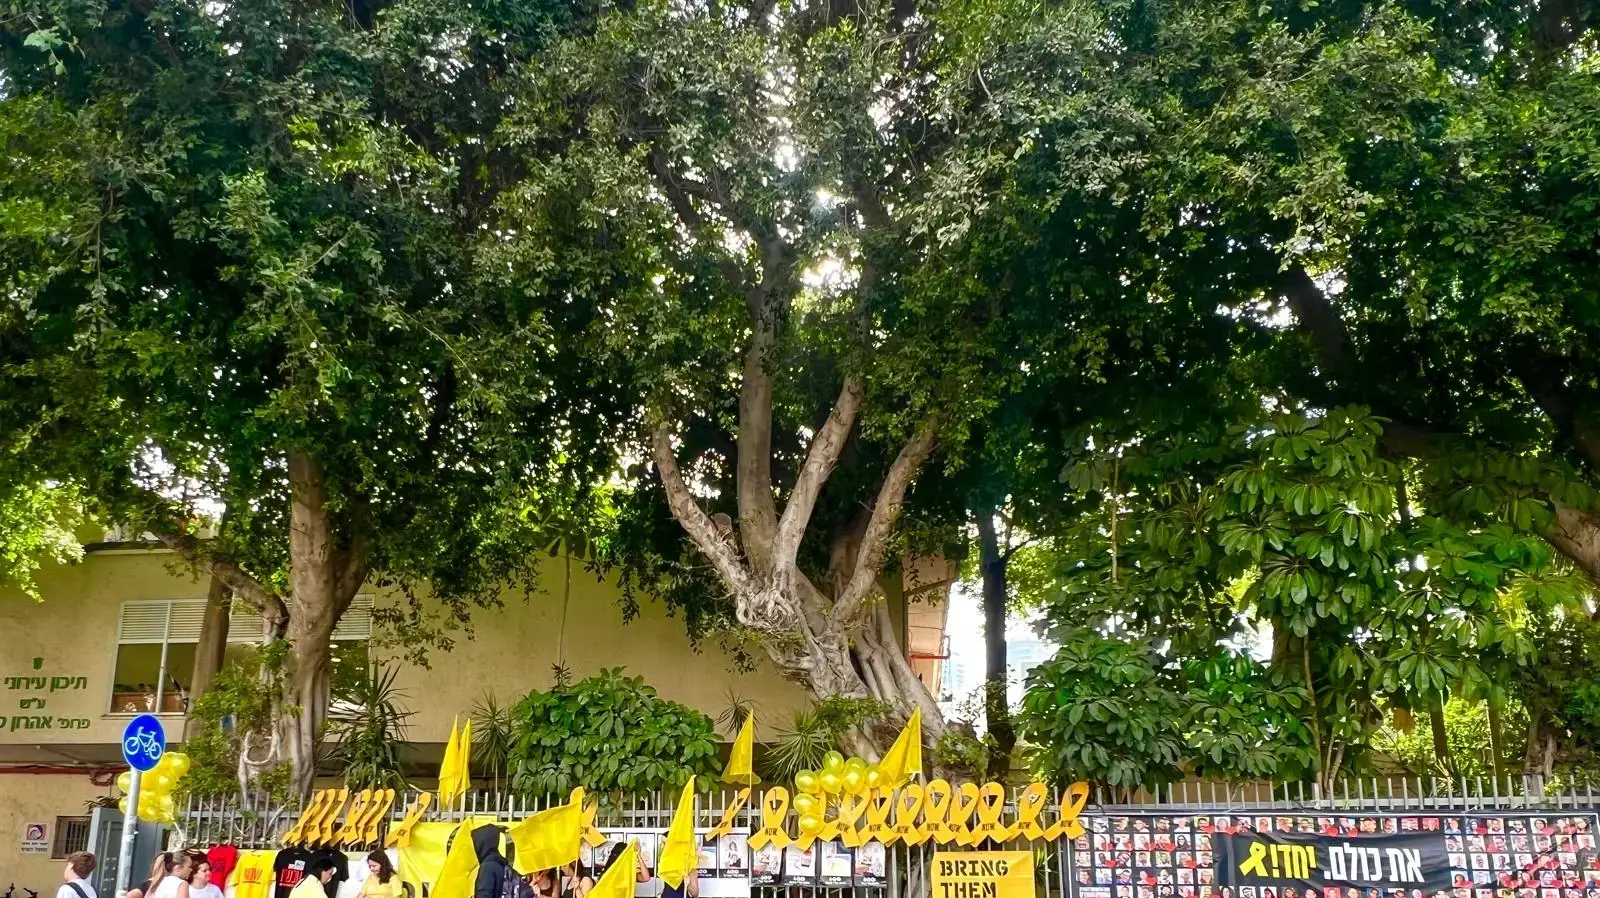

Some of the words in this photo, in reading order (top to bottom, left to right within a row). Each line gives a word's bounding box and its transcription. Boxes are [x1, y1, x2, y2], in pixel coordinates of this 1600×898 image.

[4, 677, 47, 690] עירוני
[50, 677, 87, 692] תיכון
[11, 716, 53, 732] אהרון
[940, 860, 1009, 877] BRING
[1270, 843, 1317, 880] יחד!
[1323, 842, 1383, 882] כולם.
[1386, 848, 1425, 883] את
[940, 882, 997, 898] THEM
